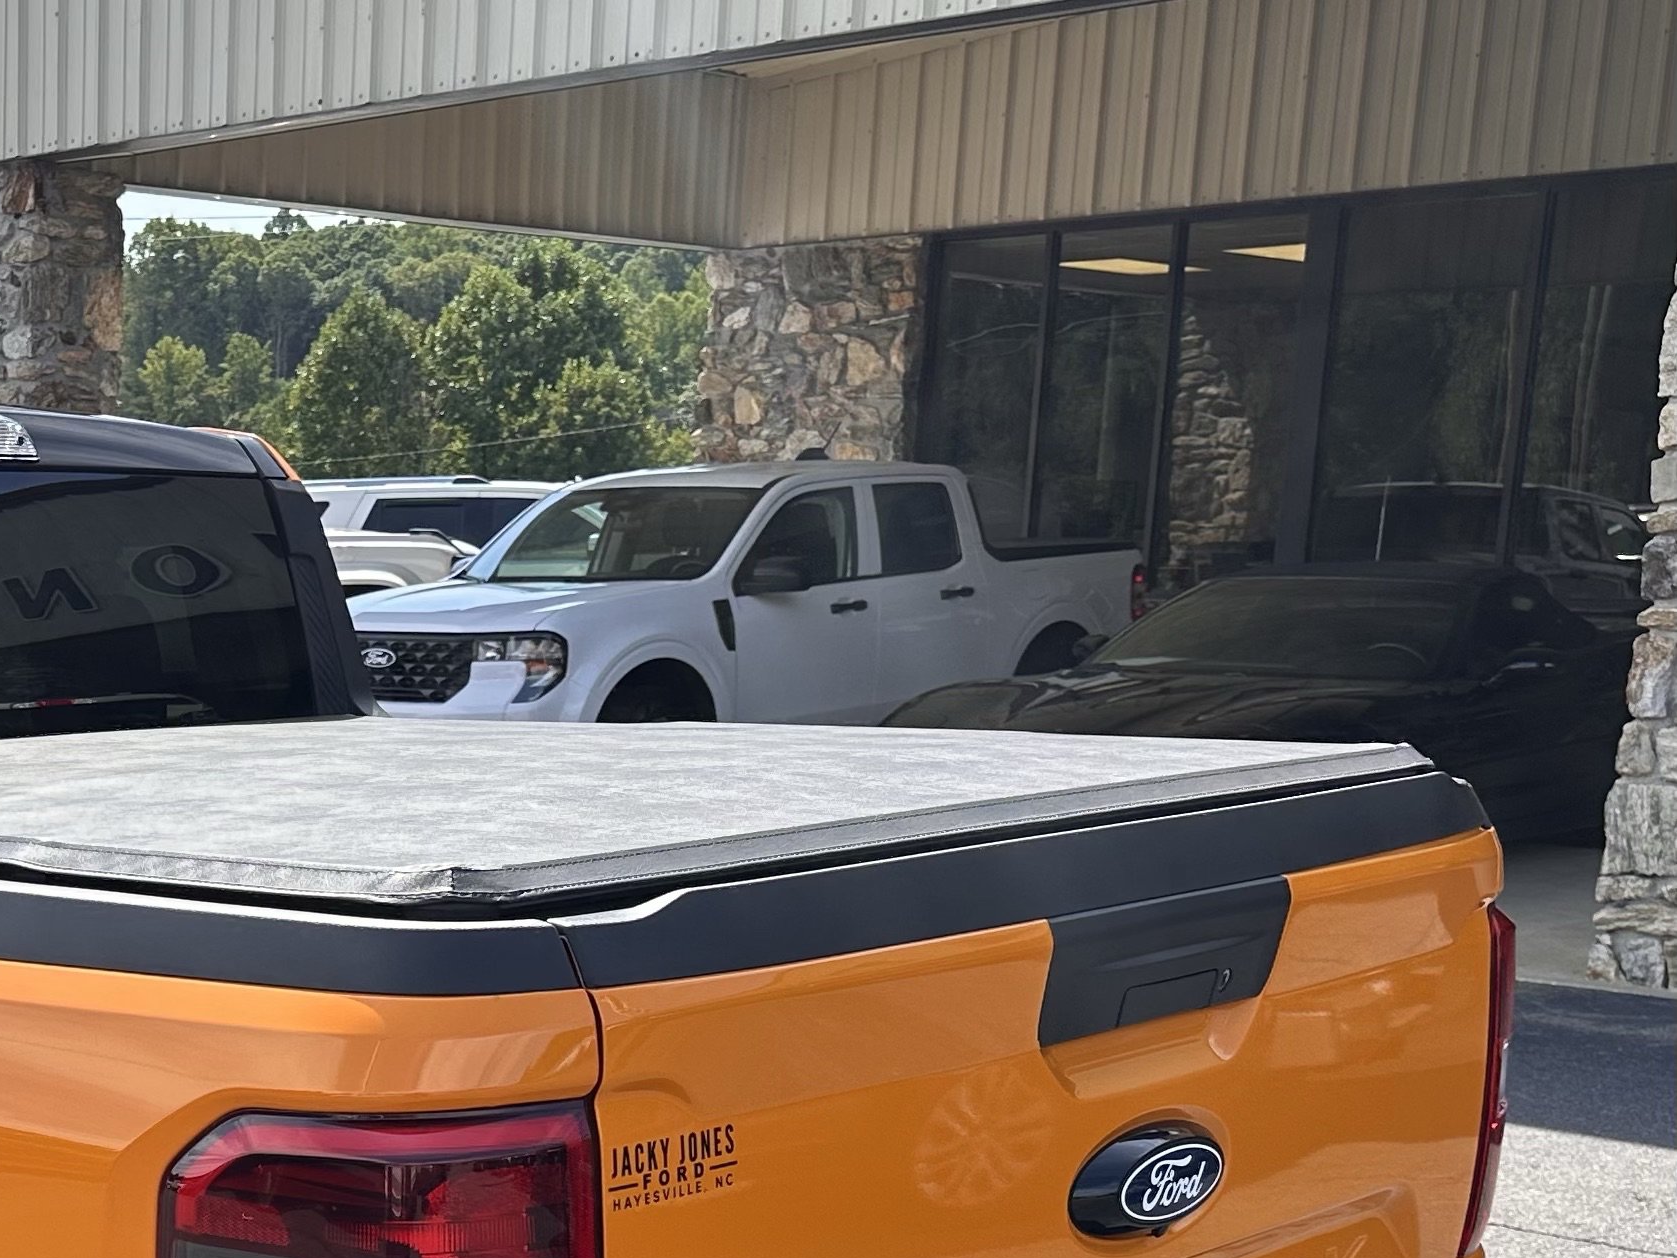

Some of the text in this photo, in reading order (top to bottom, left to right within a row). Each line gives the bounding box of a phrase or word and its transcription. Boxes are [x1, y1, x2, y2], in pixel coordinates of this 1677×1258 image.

[365, 651, 389, 665] Ford
[612, 1124, 735, 1179] JACKY JONES
[643, 1162, 704, 1190] FORD
[715, 1173, 734, 1188] NC
[1142, 1154, 1206, 1211] Ford
